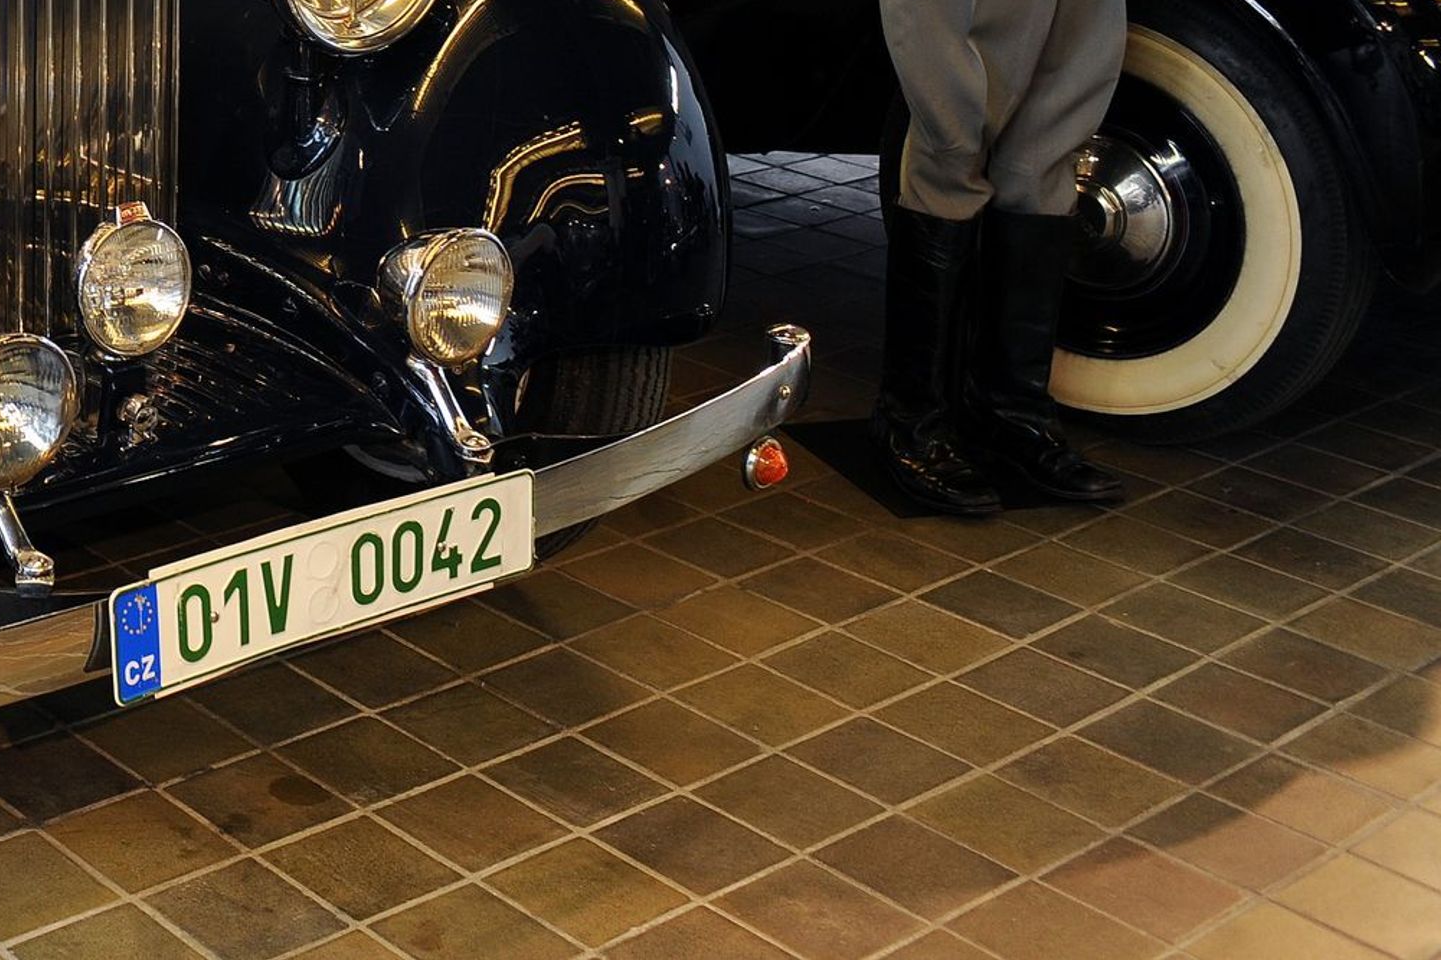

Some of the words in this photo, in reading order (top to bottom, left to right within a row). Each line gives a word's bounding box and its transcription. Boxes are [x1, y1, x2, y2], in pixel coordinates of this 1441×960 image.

[178, 554, 294, 663] 01V
[351, 497, 502, 606] 0042
[124, 654, 156, 686] CZ
